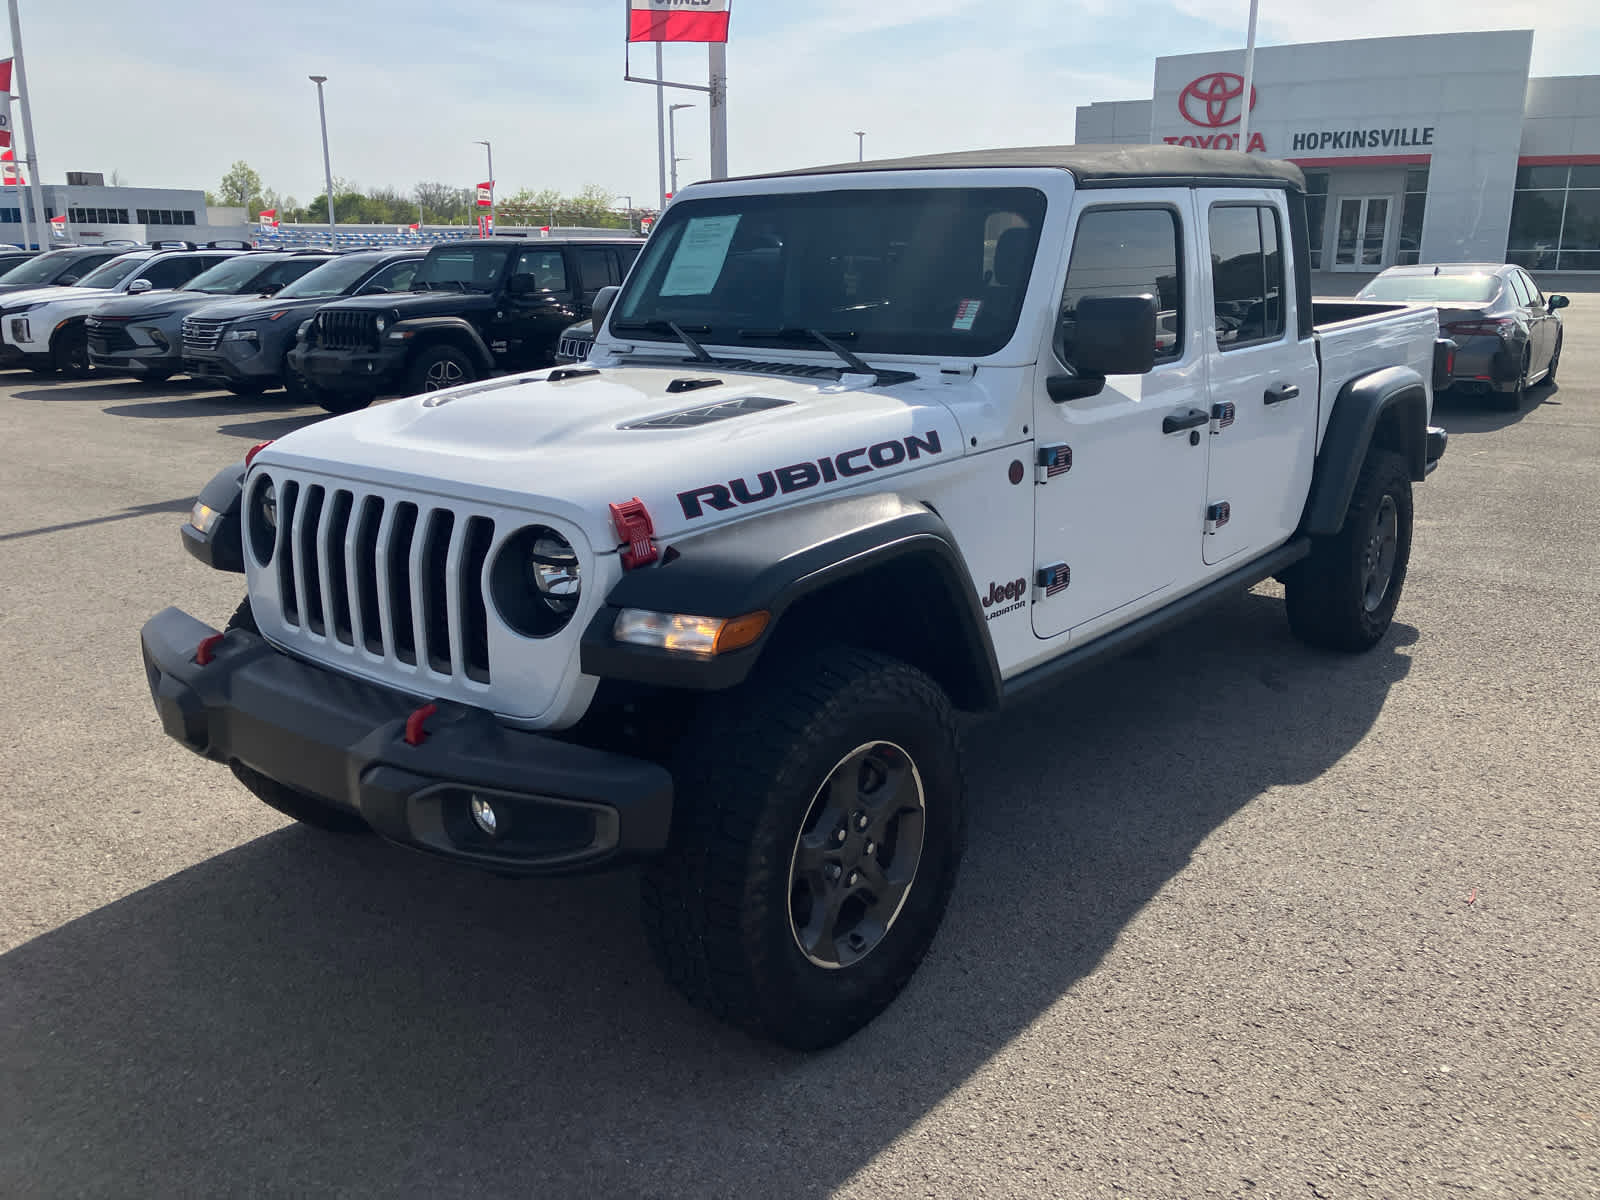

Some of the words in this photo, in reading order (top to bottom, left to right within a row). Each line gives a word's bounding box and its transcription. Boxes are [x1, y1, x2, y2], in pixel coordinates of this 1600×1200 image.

[1293, 127, 1435, 151] HOPKINSVILLE
[676, 430, 942, 520] RUBICON
[982, 577, 1026, 608] Jeep
[985, 600, 1026, 621] LADIATOR
